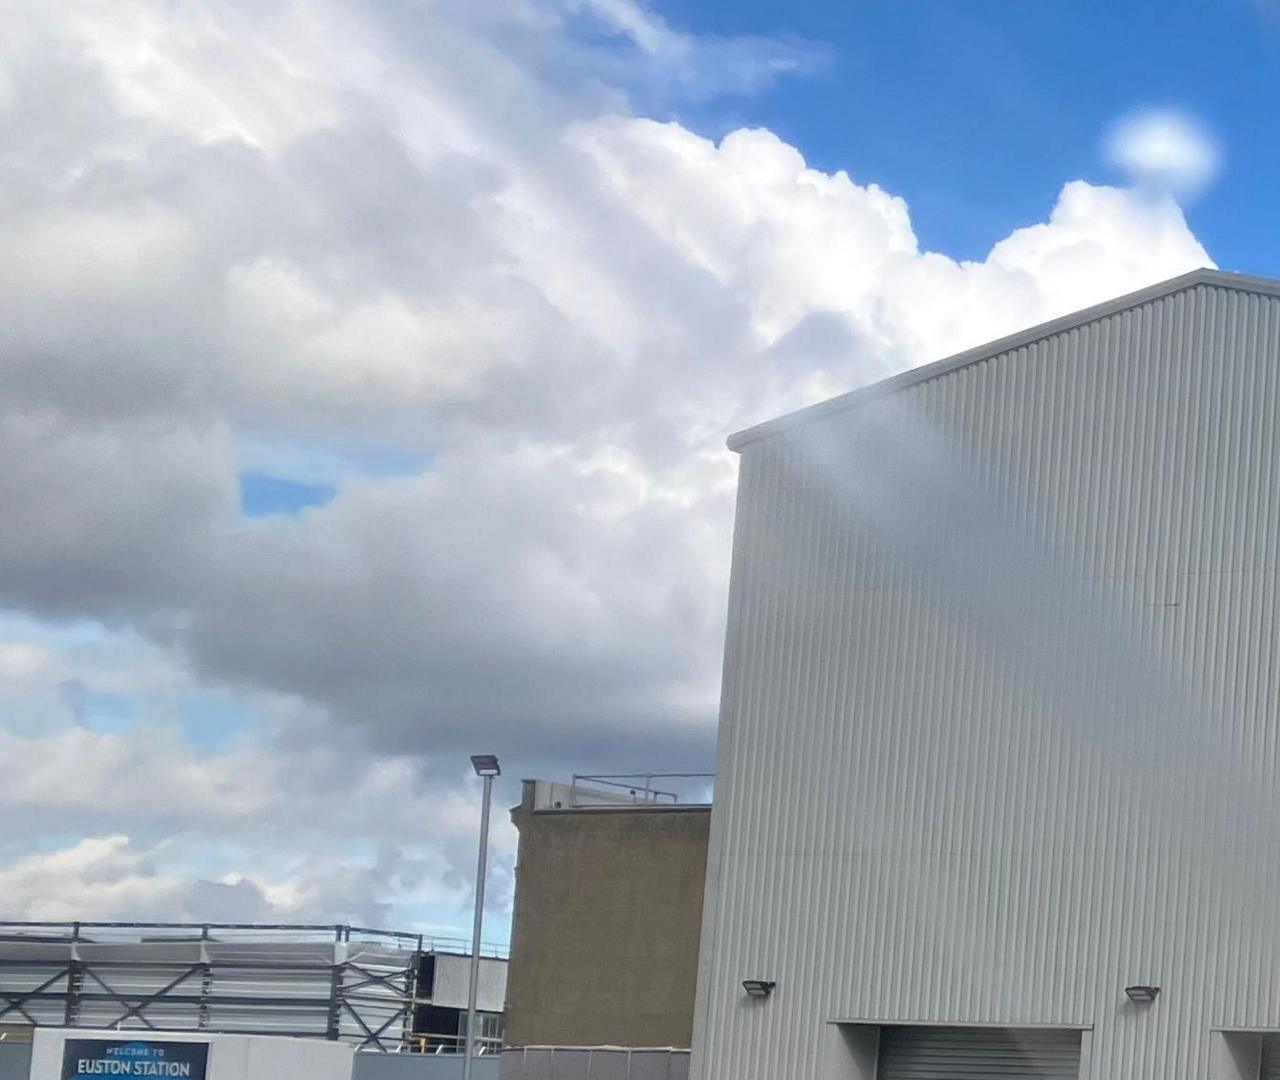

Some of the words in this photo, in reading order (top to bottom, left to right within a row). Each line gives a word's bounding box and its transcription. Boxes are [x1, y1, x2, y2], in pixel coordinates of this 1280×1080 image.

[106, 1047, 148, 1056] WELCOME
[153, 1048, 165, 1057] TO
[77, 1059, 131, 1075] EUSTON
[133, 1061, 190, 1077] STATION
